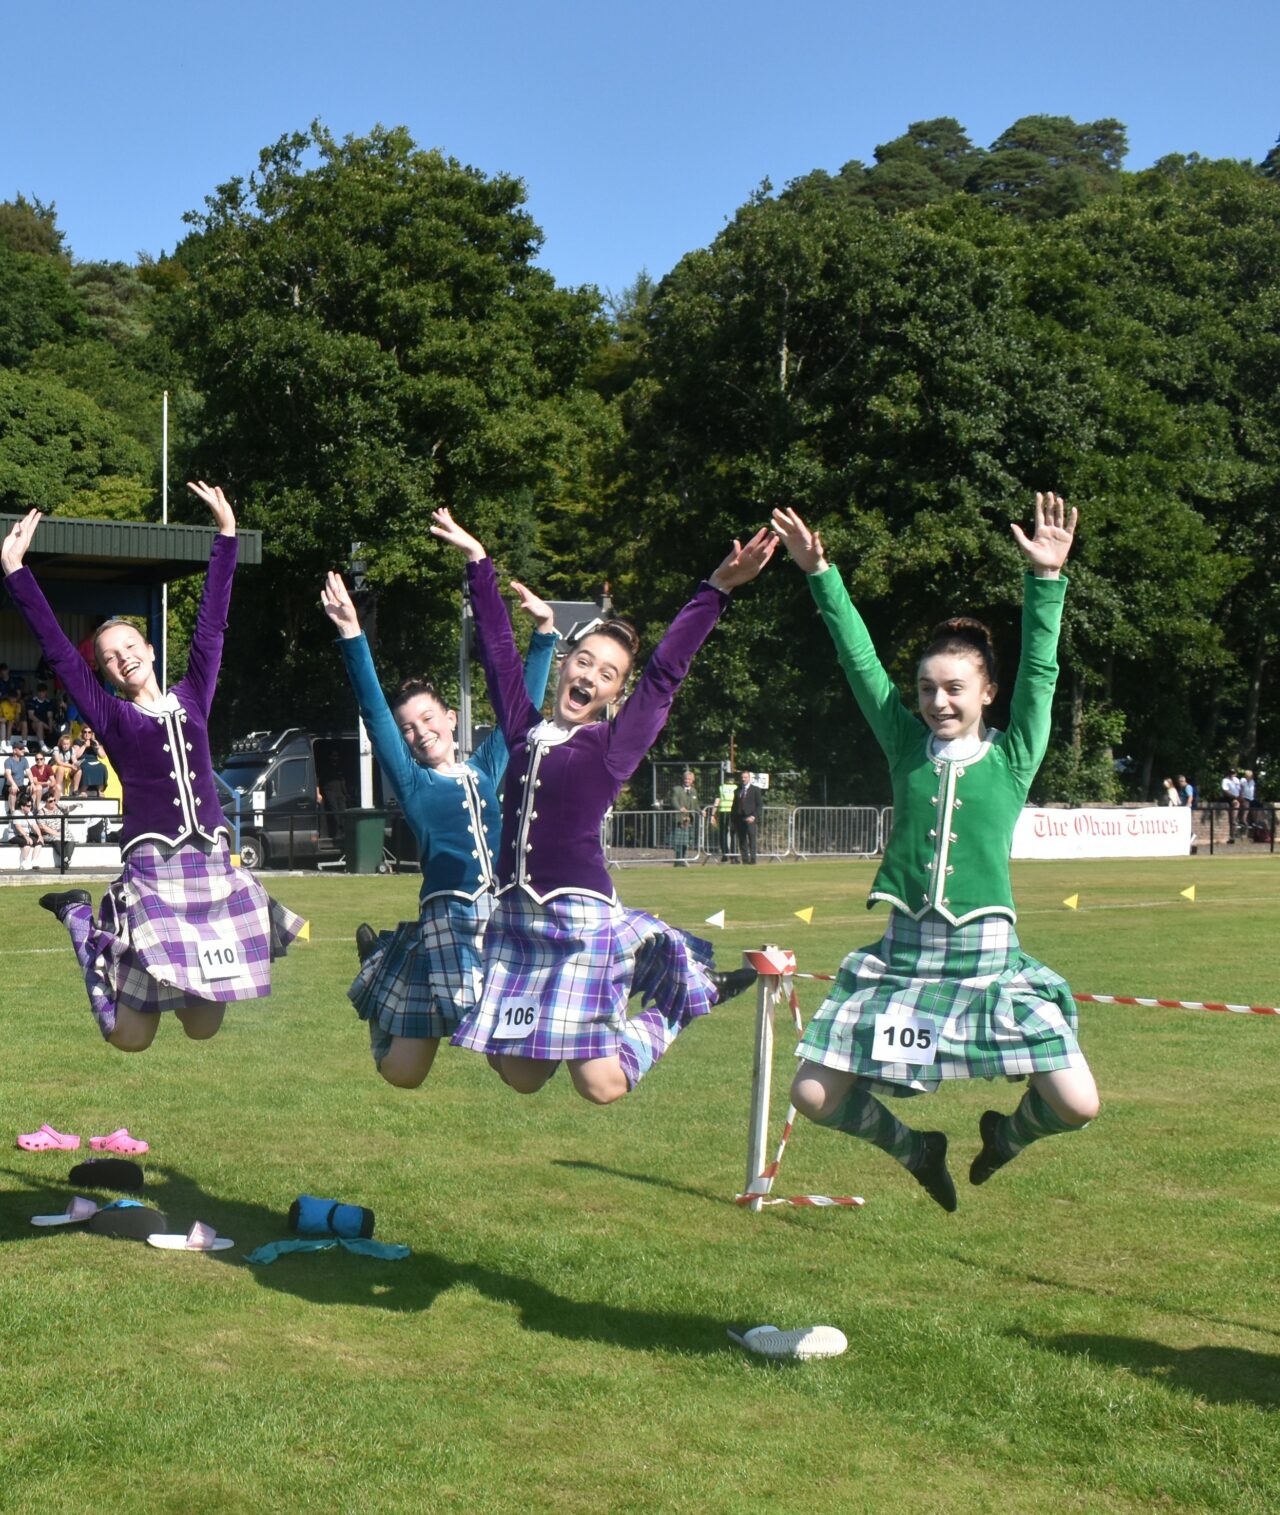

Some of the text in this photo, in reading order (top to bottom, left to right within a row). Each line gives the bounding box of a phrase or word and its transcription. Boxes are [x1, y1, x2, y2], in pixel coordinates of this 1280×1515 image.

[1034, 814, 1178, 838] The Oban Times
[203, 948, 235, 966] 110
[505, 1006, 535, 1026] 106
[883, 1026, 931, 1049] 105
